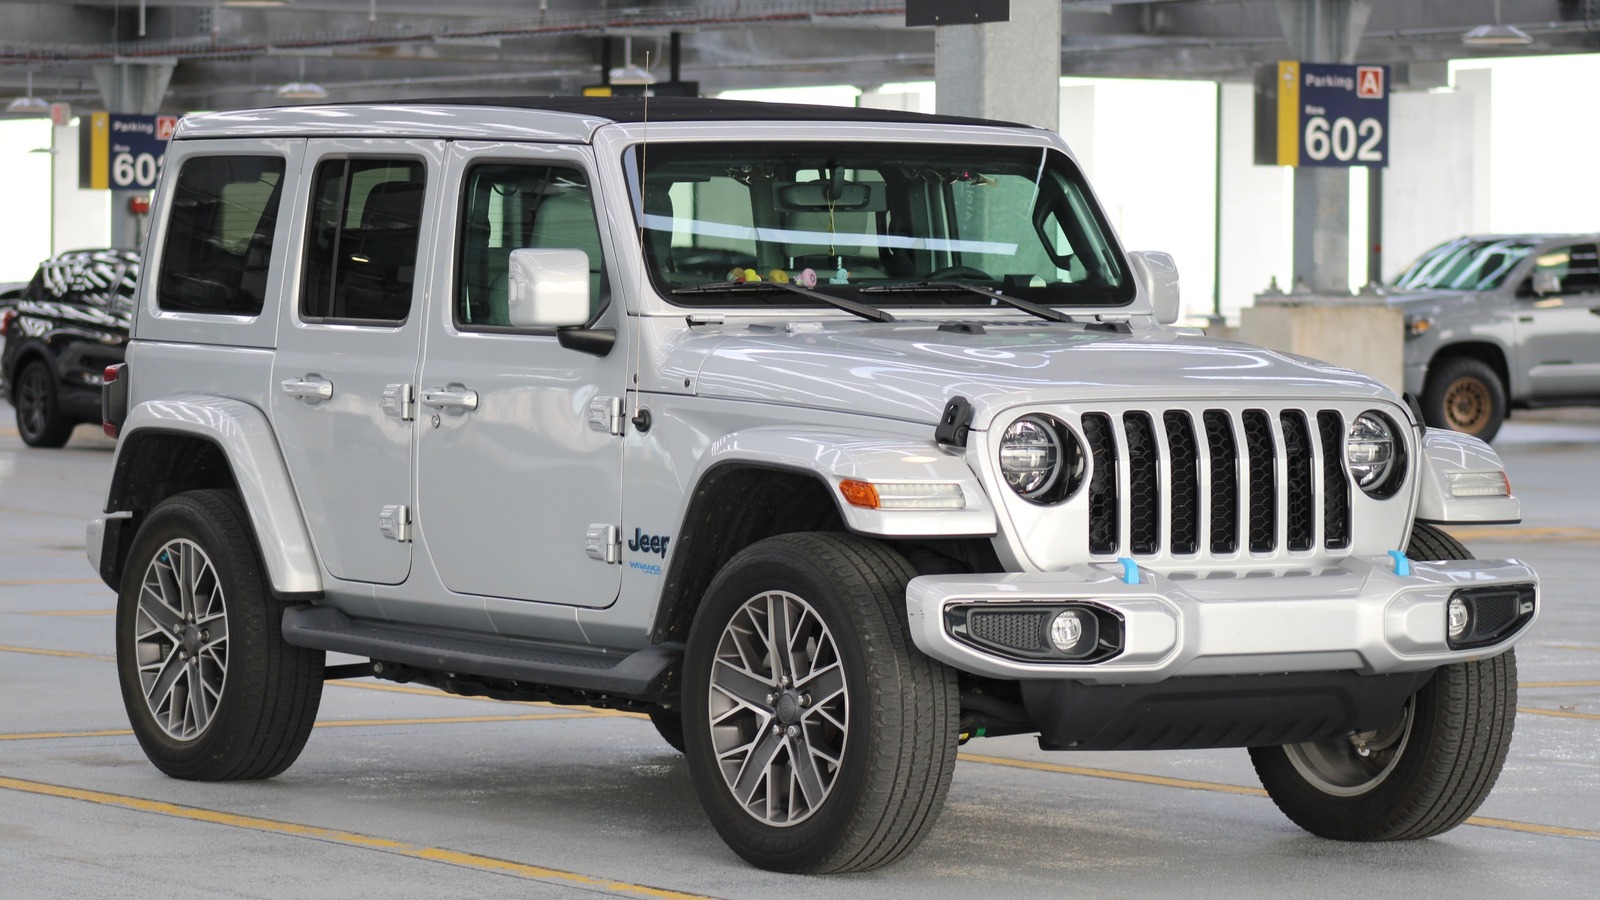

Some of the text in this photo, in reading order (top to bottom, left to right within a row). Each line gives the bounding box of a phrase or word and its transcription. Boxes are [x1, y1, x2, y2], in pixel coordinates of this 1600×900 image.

[1305, 70, 1378, 94] Parking A
[113, 120, 154, 135] Parking
[1304, 116, 1383, 161] 602
[113, 153, 164, 187] 60
